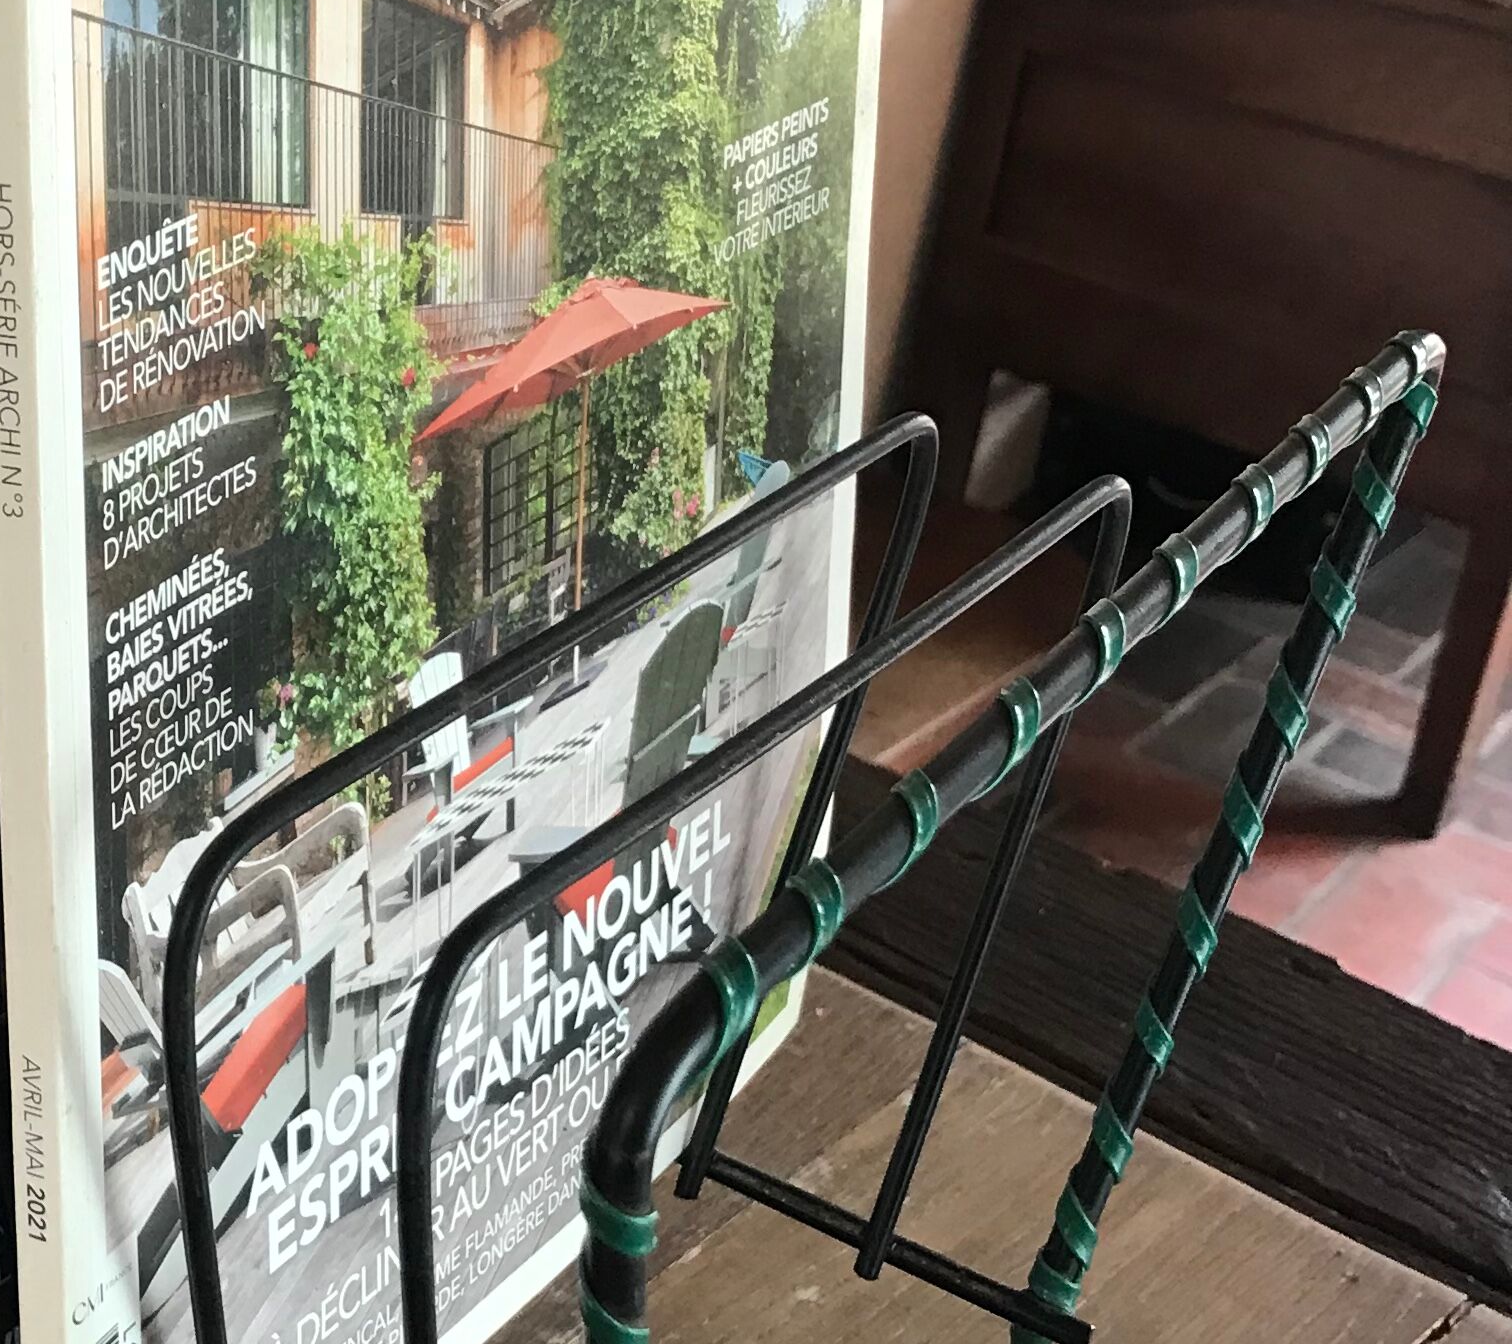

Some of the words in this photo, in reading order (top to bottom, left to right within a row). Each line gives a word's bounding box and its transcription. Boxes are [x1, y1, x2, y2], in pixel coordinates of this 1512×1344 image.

[724, 120, 779, 170] PAPIERS
[781, 97, 830, 143] PEINTS
[745, 132, 819, 189] COULEURS
[713, 227, 760, 267] VOTRE
[761, 186, 831, 243] INTÉRIEUR
[736, 166, 813, 226] FLEURISSEZ
[98, 213, 199, 291] ENQUÊTE
[99, 285, 133, 332] LES
[138, 227, 258, 313] NOUVELLES
[98, 282, 226, 373] TENDANCES
[100, 370, 130, 414] DE
[133, 301, 267, 396] RÉNOVATION
[102, 394, 232, 494] INSPIRATION
[103, 501, 115, 532] 8
[119, 447, 205, 524] PROJETS
[104, 456, 258, 571] D'ARCHITECTES
[105, 547, 231, 646] CHEMINÉES,
[107, 622, 164, 685] BAIES
[168, 570, 255, 641] VITRÉES,
[110, 715, 141, 758] LES
[146, 663, 215, 727] COUPS
[111, 752, 138, 796] DE
[141, 709, 202, 769] CŒUR
[205, 687, 233, 728] DE
[111, 789, 137, 831] LA
[139, 708, 255, 810] RÉDACTION
[245, 978, 486, 1220] ADOPZ
[498, 930, 548, 1017] LE
[563, 799, 732, 956] NOUVEL
[22, 1054, 45, 1179] AVRIL-MAI
[268, 1111, 398, 1275] ESPRI
[445, 890, 694, 1122] CAMPAGNE
[435, 1091, 526, 1198] PAGES
[532, 1006, 631, 1120] D'IDÉES
[449, 1162, 491, 1233] AU
[497, 1102, 565, 1188] VERT
[568, 1065, 609, 1128] OU
[26, 1183, 48, 1243] 2021
[464, 1165, 558, 1253] FLAMANDE,
[469, 1201, 545, 1285] LONGÈRE
